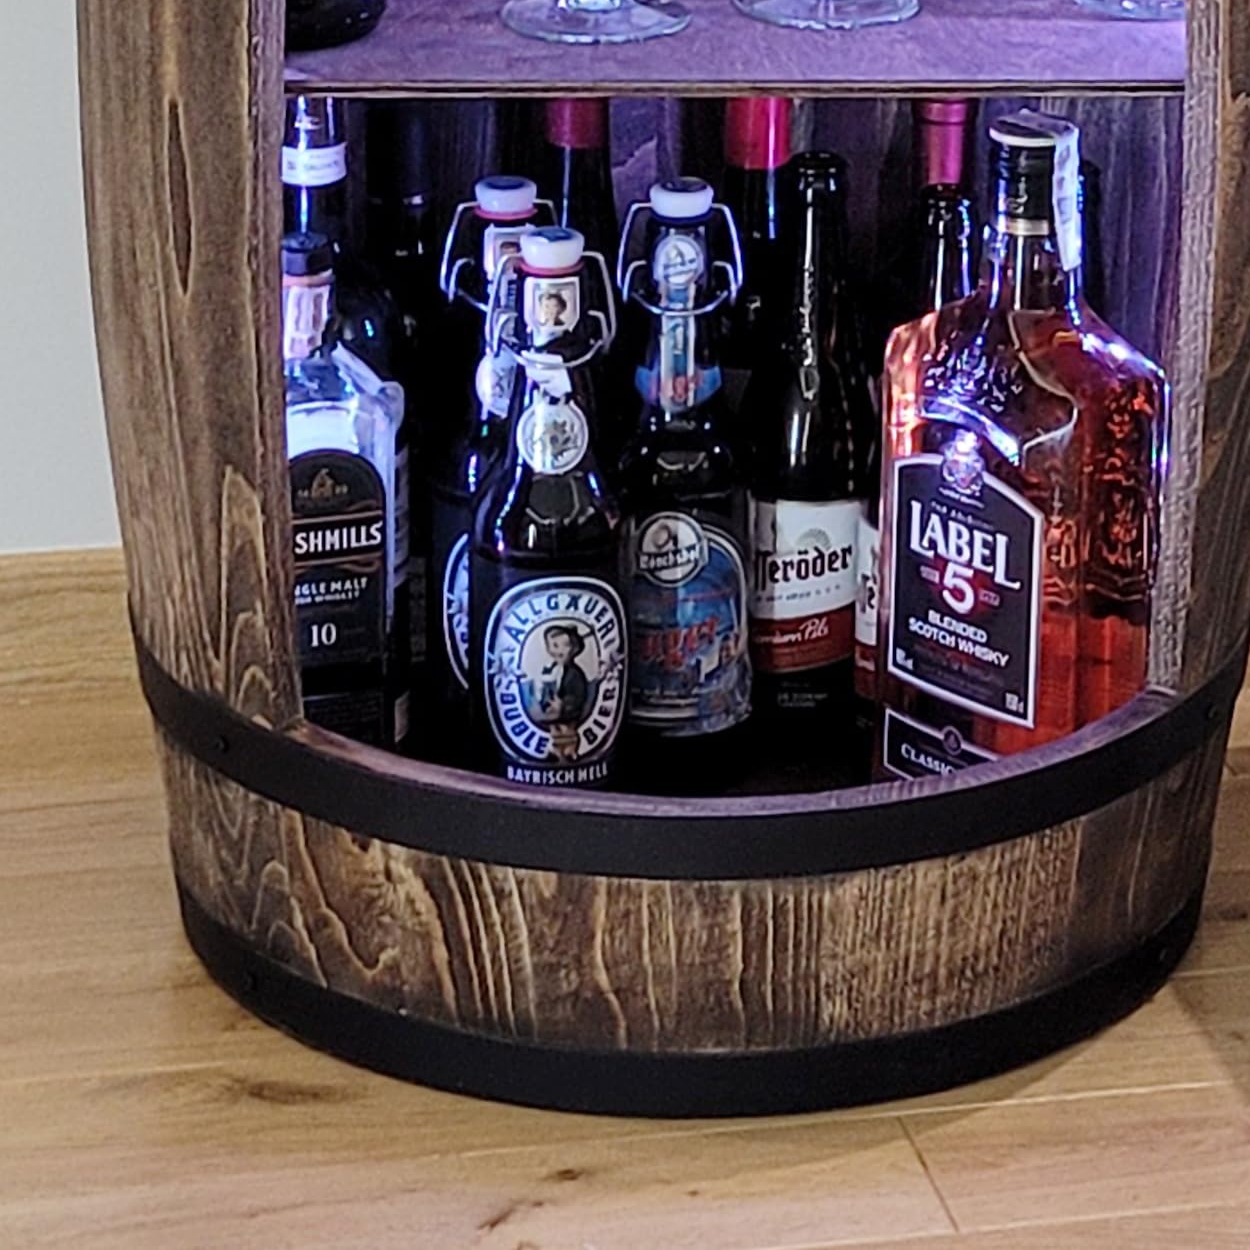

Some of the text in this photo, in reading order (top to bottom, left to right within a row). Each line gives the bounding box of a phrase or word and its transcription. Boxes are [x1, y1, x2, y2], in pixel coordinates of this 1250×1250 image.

[294, 522, 383, 554] SHMILLS
[910, 499, 1021, 590] LABEL
[330, 576, 367, 592] MALT
[942, 562, 974, 614] 5
[311, 623, 336, 647] 10
[908, 617, 1009, 667] SCOTCH WHISKY
[928, 610, 987, 643] BLENDED
[583, 686, 617, 745] BIER
